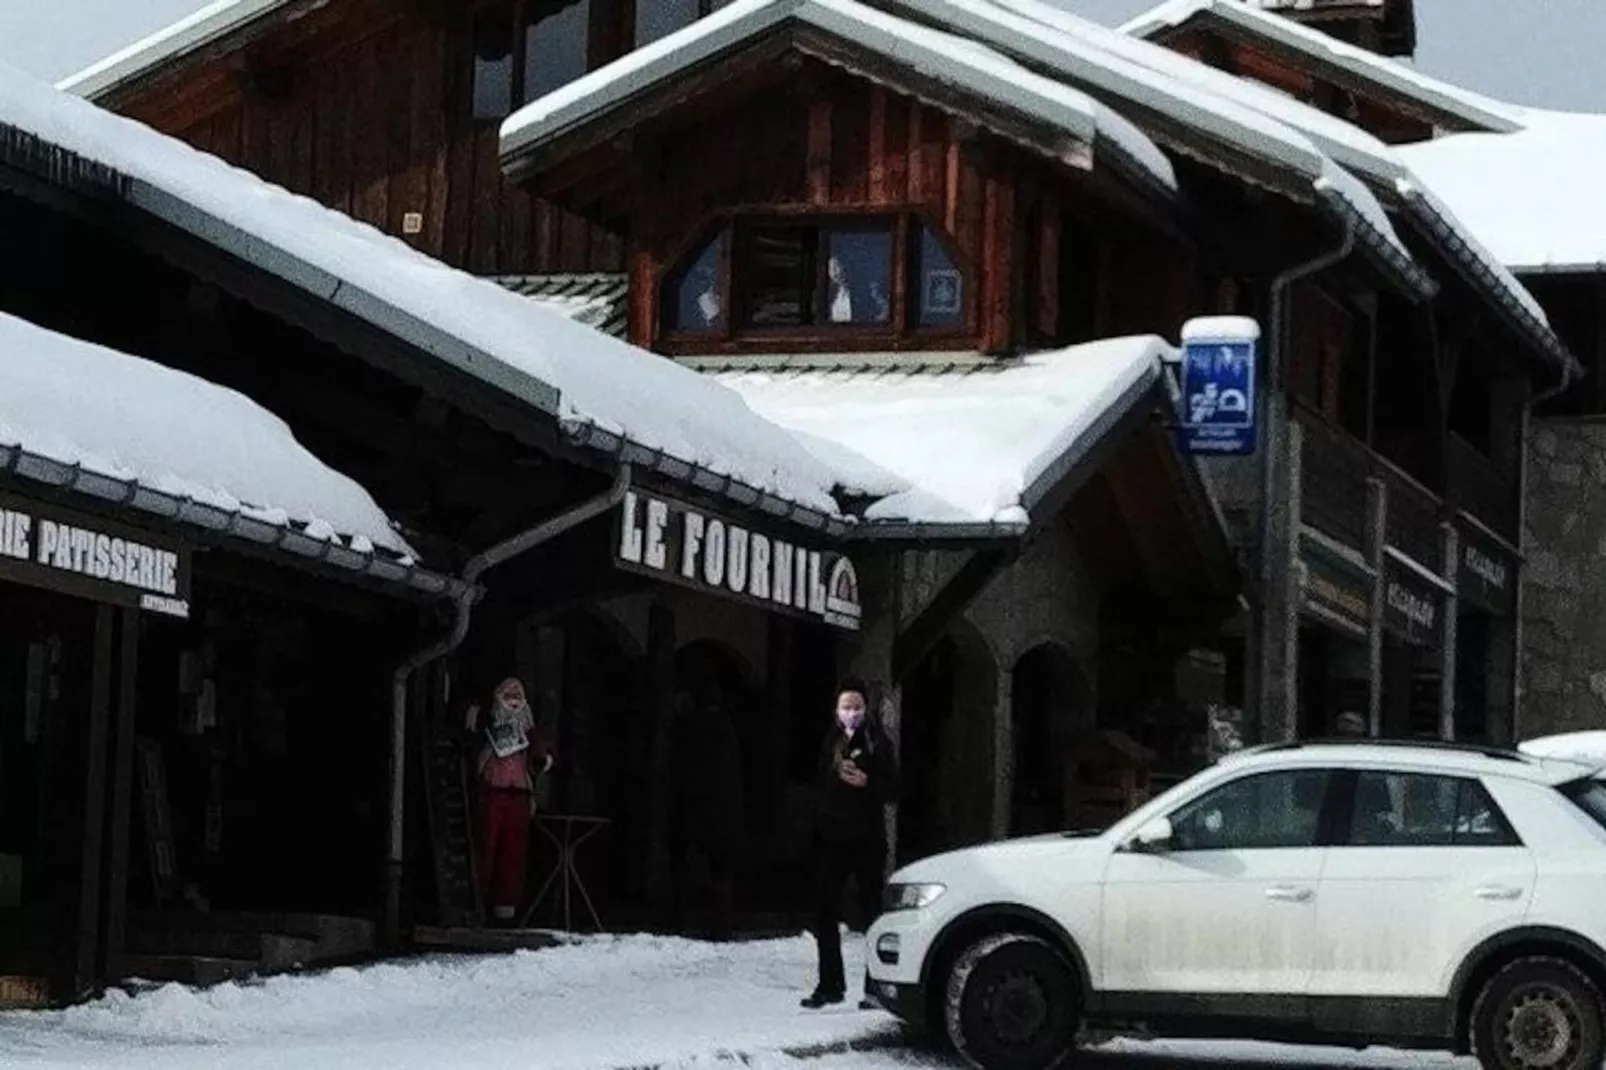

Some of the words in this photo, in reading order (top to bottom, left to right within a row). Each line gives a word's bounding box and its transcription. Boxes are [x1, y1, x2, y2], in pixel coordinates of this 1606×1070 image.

[37, 520, 178, 595] PATISSERIE
[620, 491, 668, 569] LE
[681, 511, 826, 614] FOURNIL
